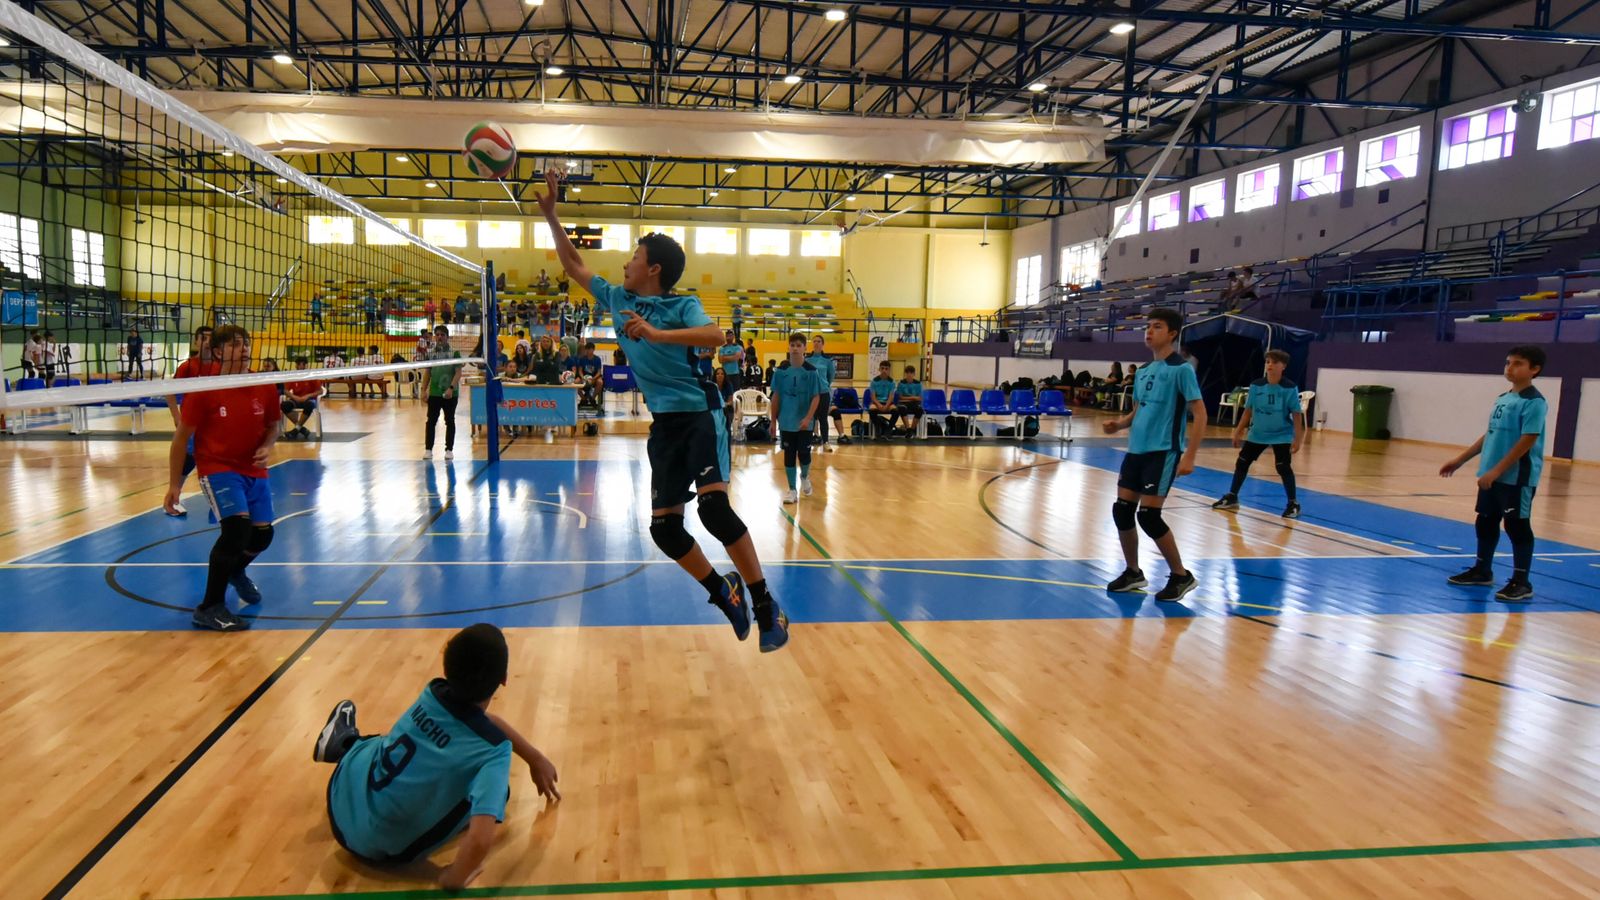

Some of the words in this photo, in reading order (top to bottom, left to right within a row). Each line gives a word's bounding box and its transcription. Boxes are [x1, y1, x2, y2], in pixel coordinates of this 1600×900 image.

[750, 366, 761, 376] 13
[500, 398, 557, 411] eportes
[1268, 394, 1275, 405] 11
[220, 406, 227, 417] 6
[410, 704, 452, 750] NACHO
[367, 733, 417, 793] 9
